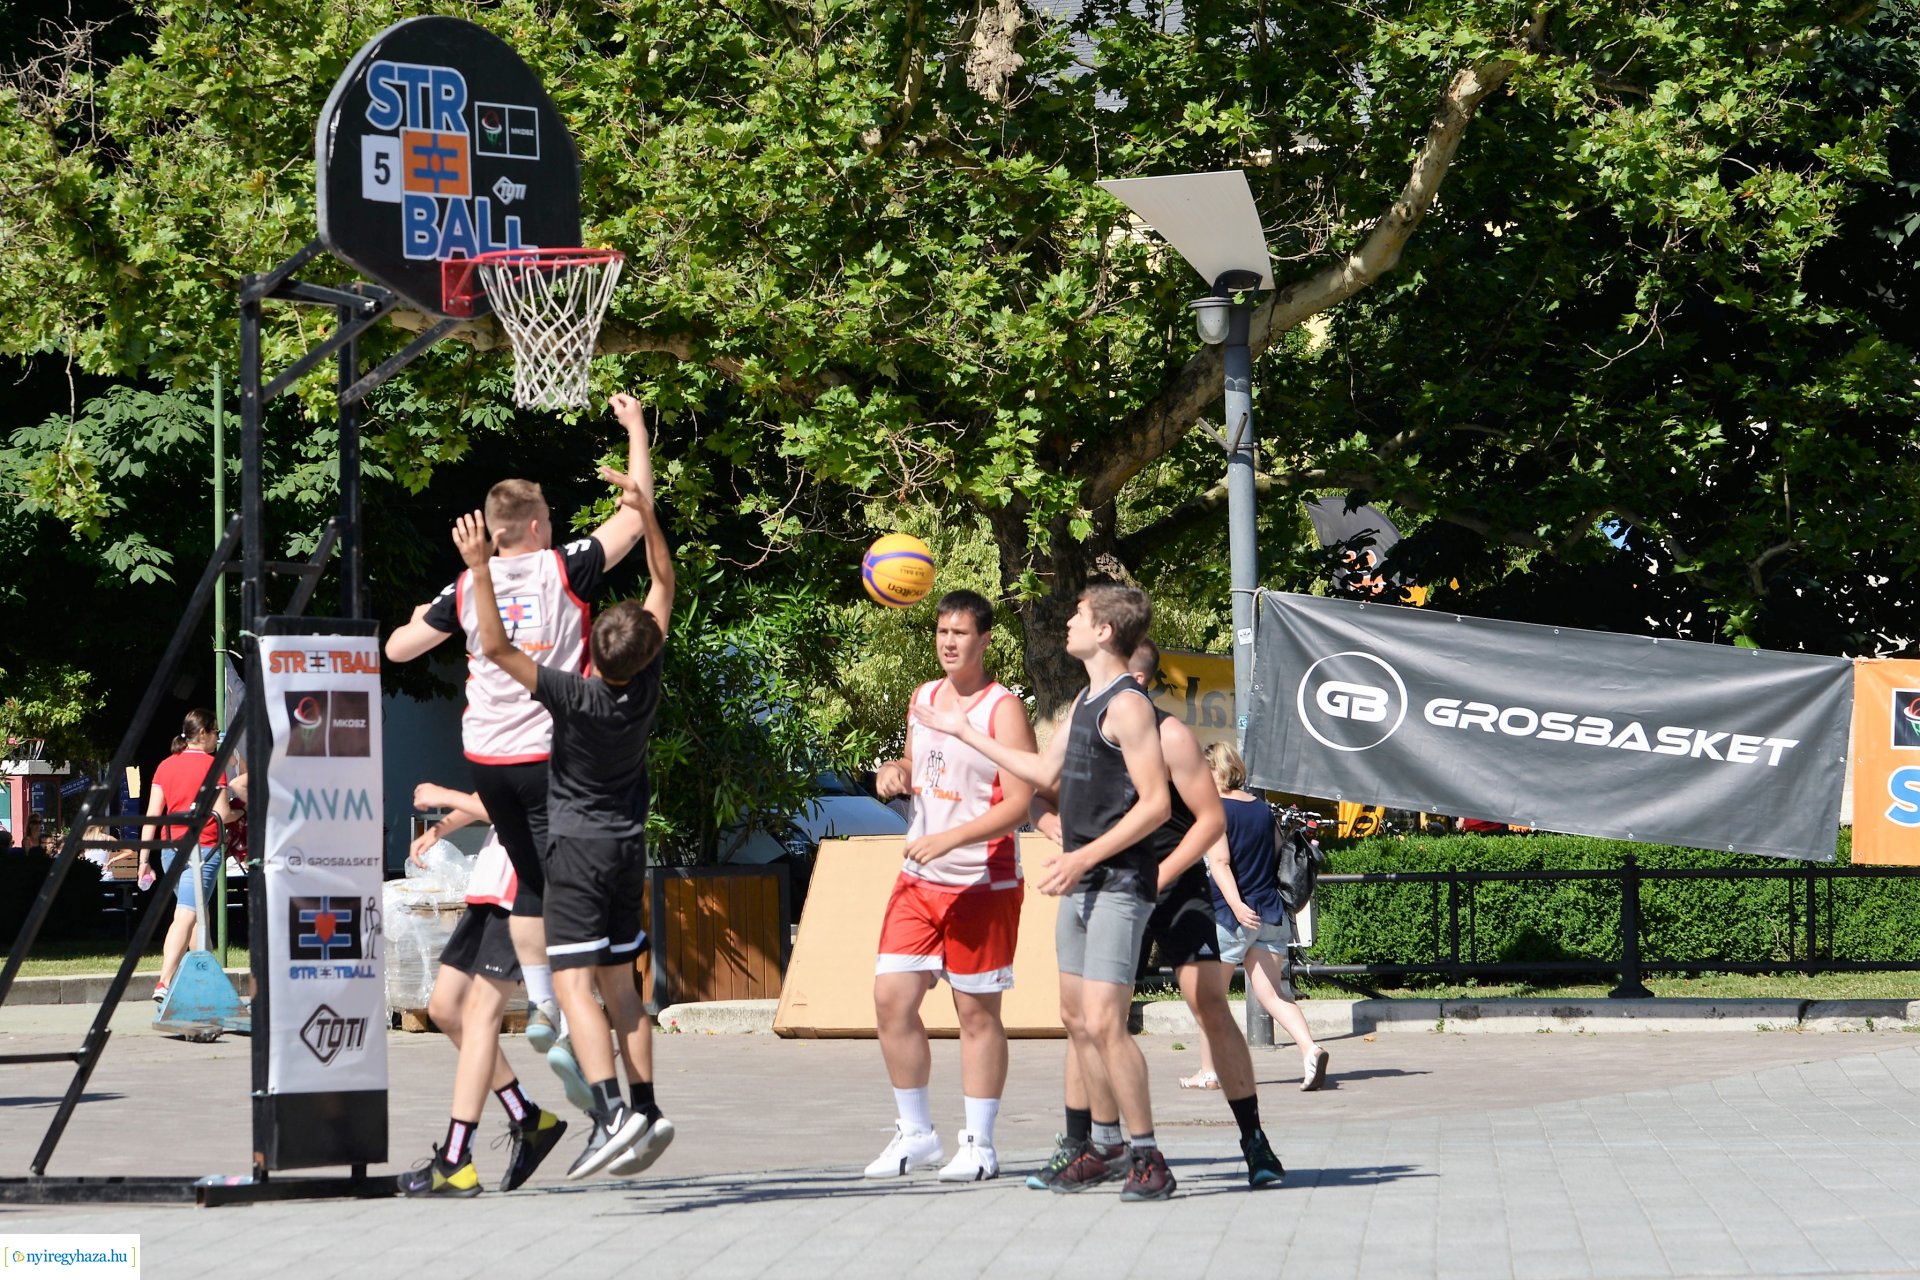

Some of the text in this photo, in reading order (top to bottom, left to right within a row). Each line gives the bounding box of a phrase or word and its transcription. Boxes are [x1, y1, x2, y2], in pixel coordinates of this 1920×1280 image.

[365, 60, 469, 134] STR
[373, 151, 392, 186] 5
[402, 194, 539, 262] BALL
[1316, 680, 1800, 767] GB GROSBASKET
[288, 788, 373, 821] MVM
[307, 857, 380, 867] GROSBASKET
[315, 1017, 370, 1050] TOTI
